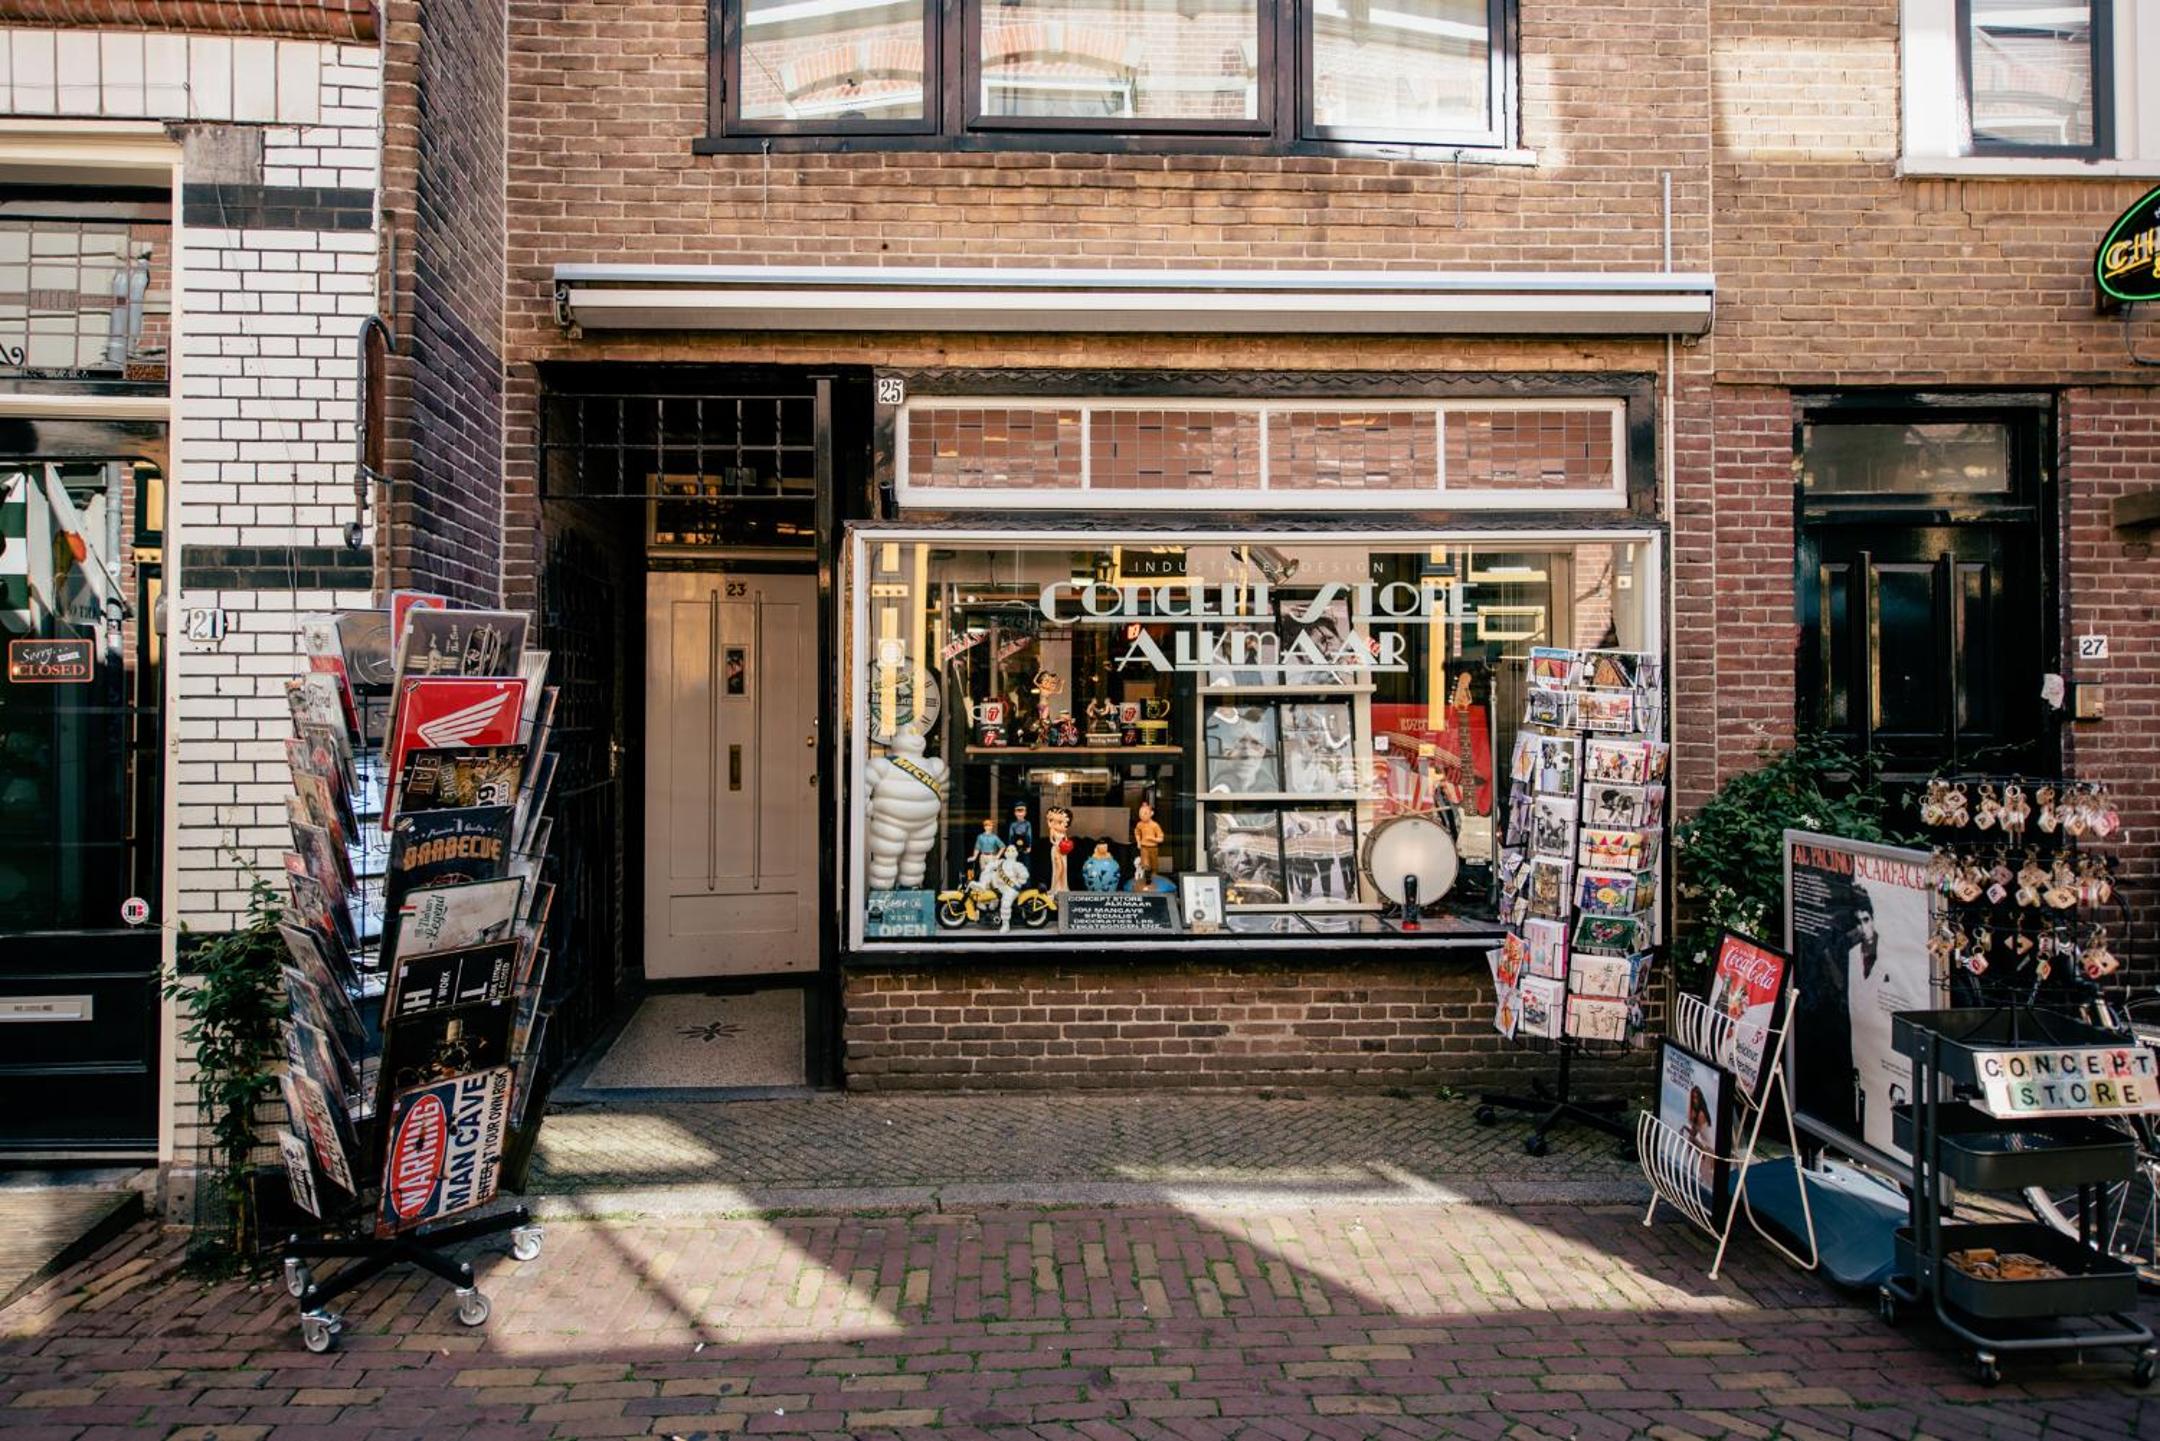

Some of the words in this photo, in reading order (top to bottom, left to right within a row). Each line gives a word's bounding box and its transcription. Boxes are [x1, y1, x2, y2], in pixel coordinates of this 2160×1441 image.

[880, 380, 902, 403] 25
[1302, 561, 1384, 574] DESIGN
[727, 583, 745, 597] 23
[193, 610, 219, 639] 21
[2082, 639, 2104, 656] 27
[18, 664, 86, 677] CLOSED
[410, 758, 437, 793] EAT
[441, 765, 458, 799] DRIVE
[478, 786, 496, 806] 6
[403, 835, 502, 870] BARBECUE
[1794, 843, 1810, 864] AL
[1811, 846, 1854, 876] PACINO
[1857, 853, 1926, 890] SCARFACE
[425, 894, 448, 941] Legend
[879, 924, 928, 937] OPEN
[1724, 946, 1778, 990] Coca-Cola
[438, 971, 451, 998] WORK
[1985, 1052, 2148, 1077] CONCEPT
[496, 1070, 508, 1097] RISK
[2021, 1083, 2137, 1106] STORE
[455, 1074, 488, 1148] CAVE
[490, 1096, 502, 1122] OWN
[486, 1121, 500, 1151] YOUR
[399, 1101, 440, 1213] WARNING
[445, 1149, 476, 1212] MAN
[477, 1164, 491, 1201] ENTER
